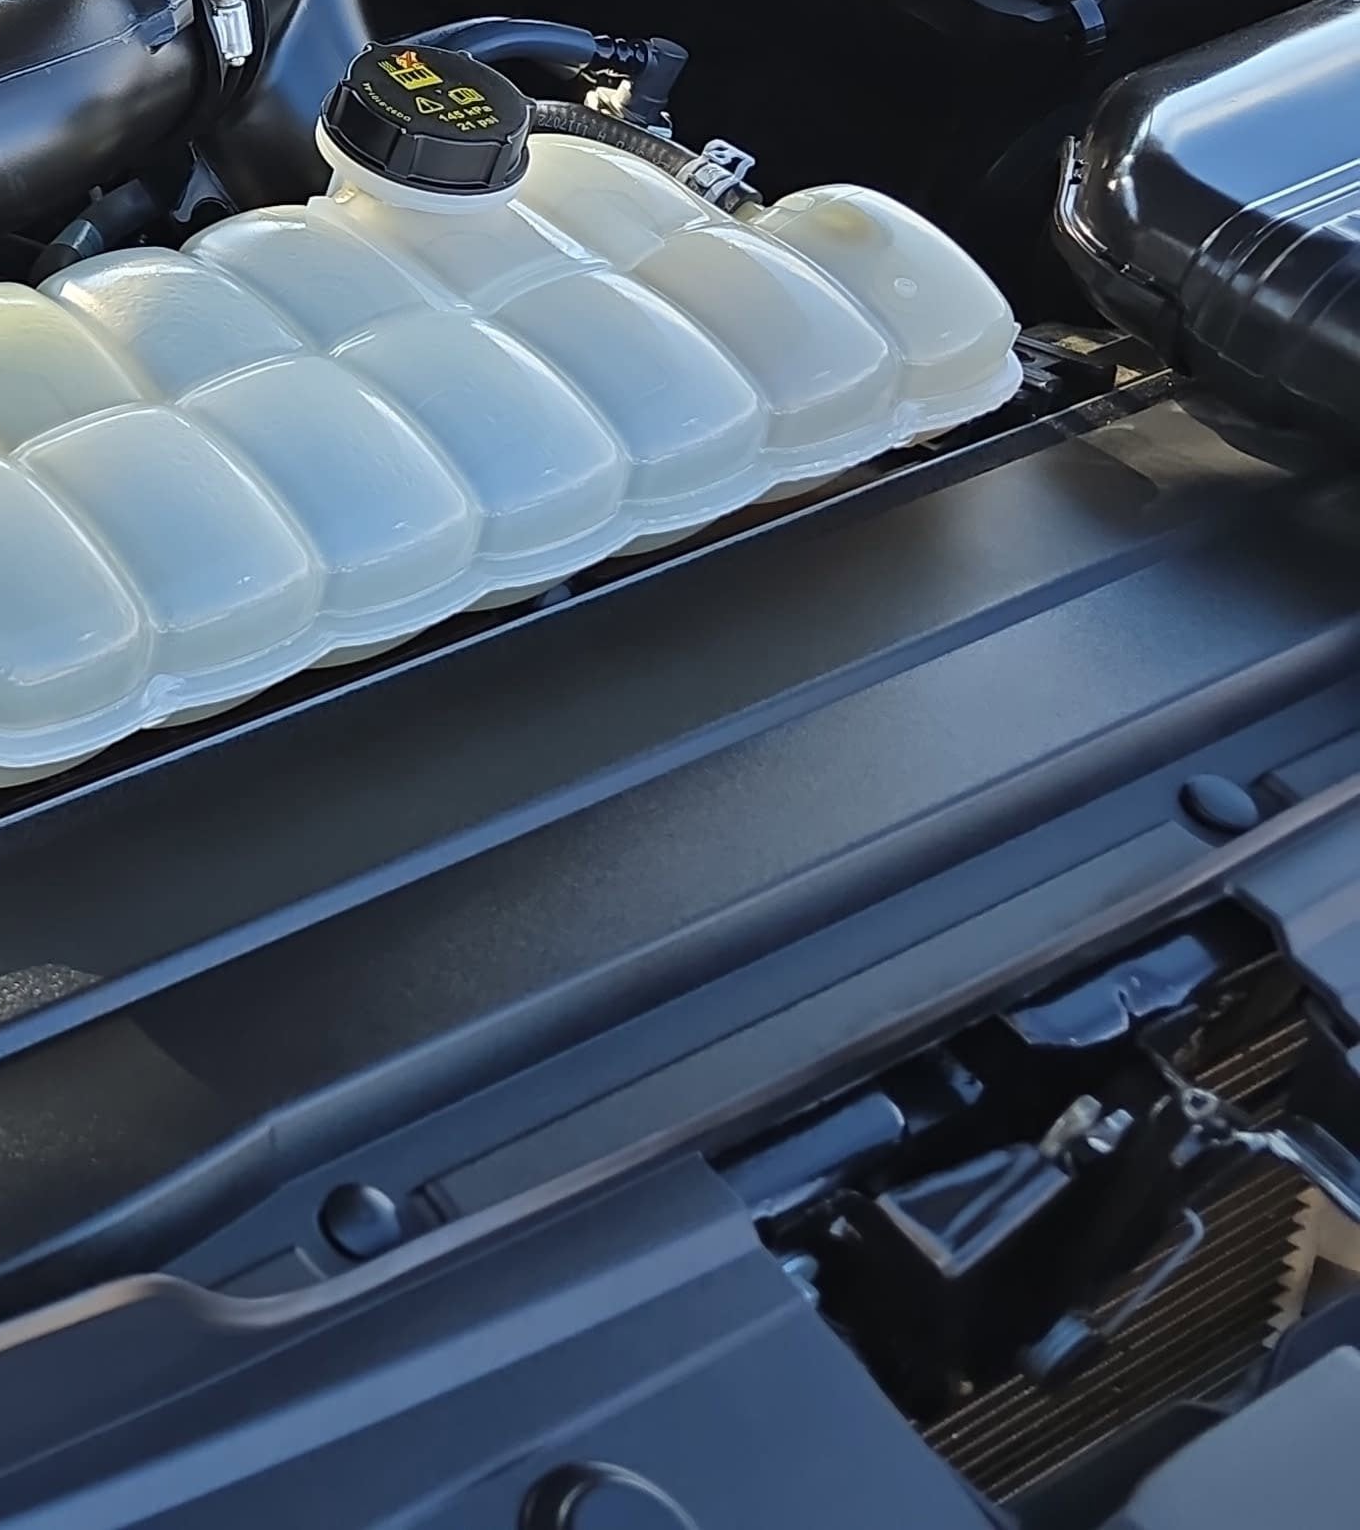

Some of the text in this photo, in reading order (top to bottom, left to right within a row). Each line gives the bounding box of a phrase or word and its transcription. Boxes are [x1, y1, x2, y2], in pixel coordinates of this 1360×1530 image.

[439, 104, 494, 124] 145 kPa
[456, 115, 500, 133] 21 psi
